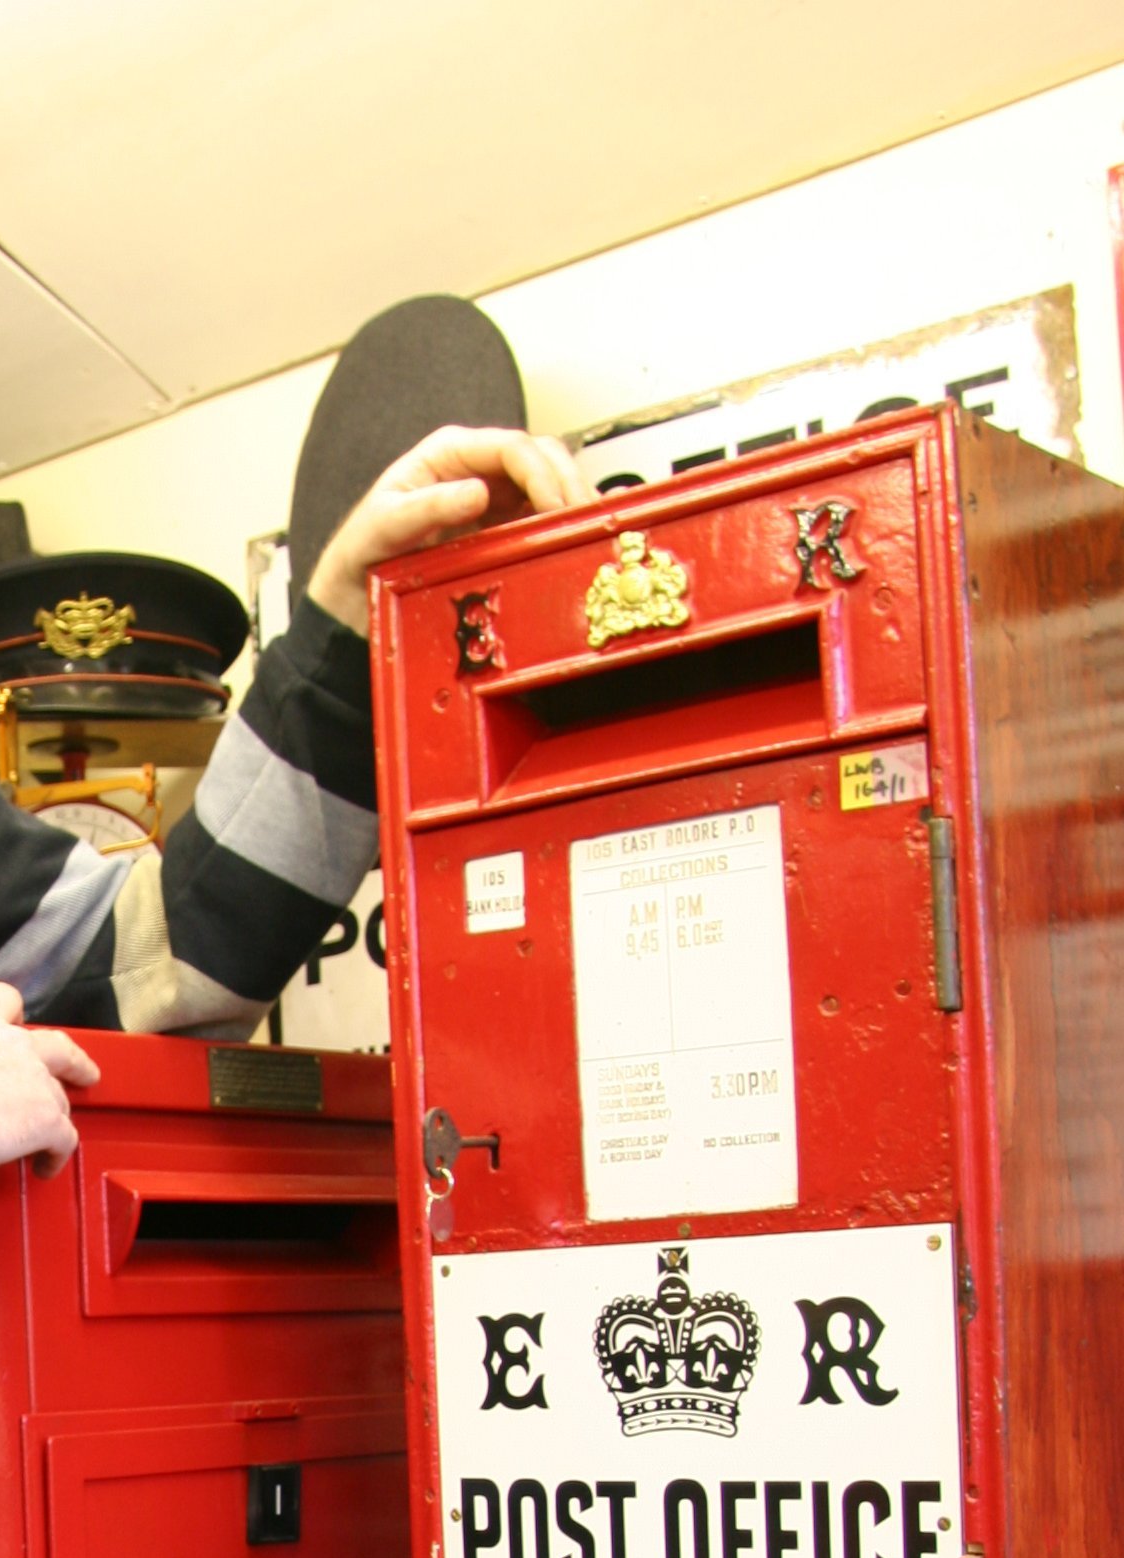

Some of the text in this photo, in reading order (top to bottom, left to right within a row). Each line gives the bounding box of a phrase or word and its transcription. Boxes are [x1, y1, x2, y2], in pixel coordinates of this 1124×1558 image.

[622, 831, 658, 855] EAST
[482, 870, 505, 887] 105
[620, 855, 728, 888] COLLECTIONS
[597, 1062, 660, 1082] SUNDAYS
[627, 1095, 666, 1108] HOLIDAYS
[600, 1133, 669, 1150] CHRISTMAS DAY
[703, 1132, 780, 1148] NO COLLECTION
[644, 1149, 663, 1160] DAY
[477, 1296, 900, 1411] E R
